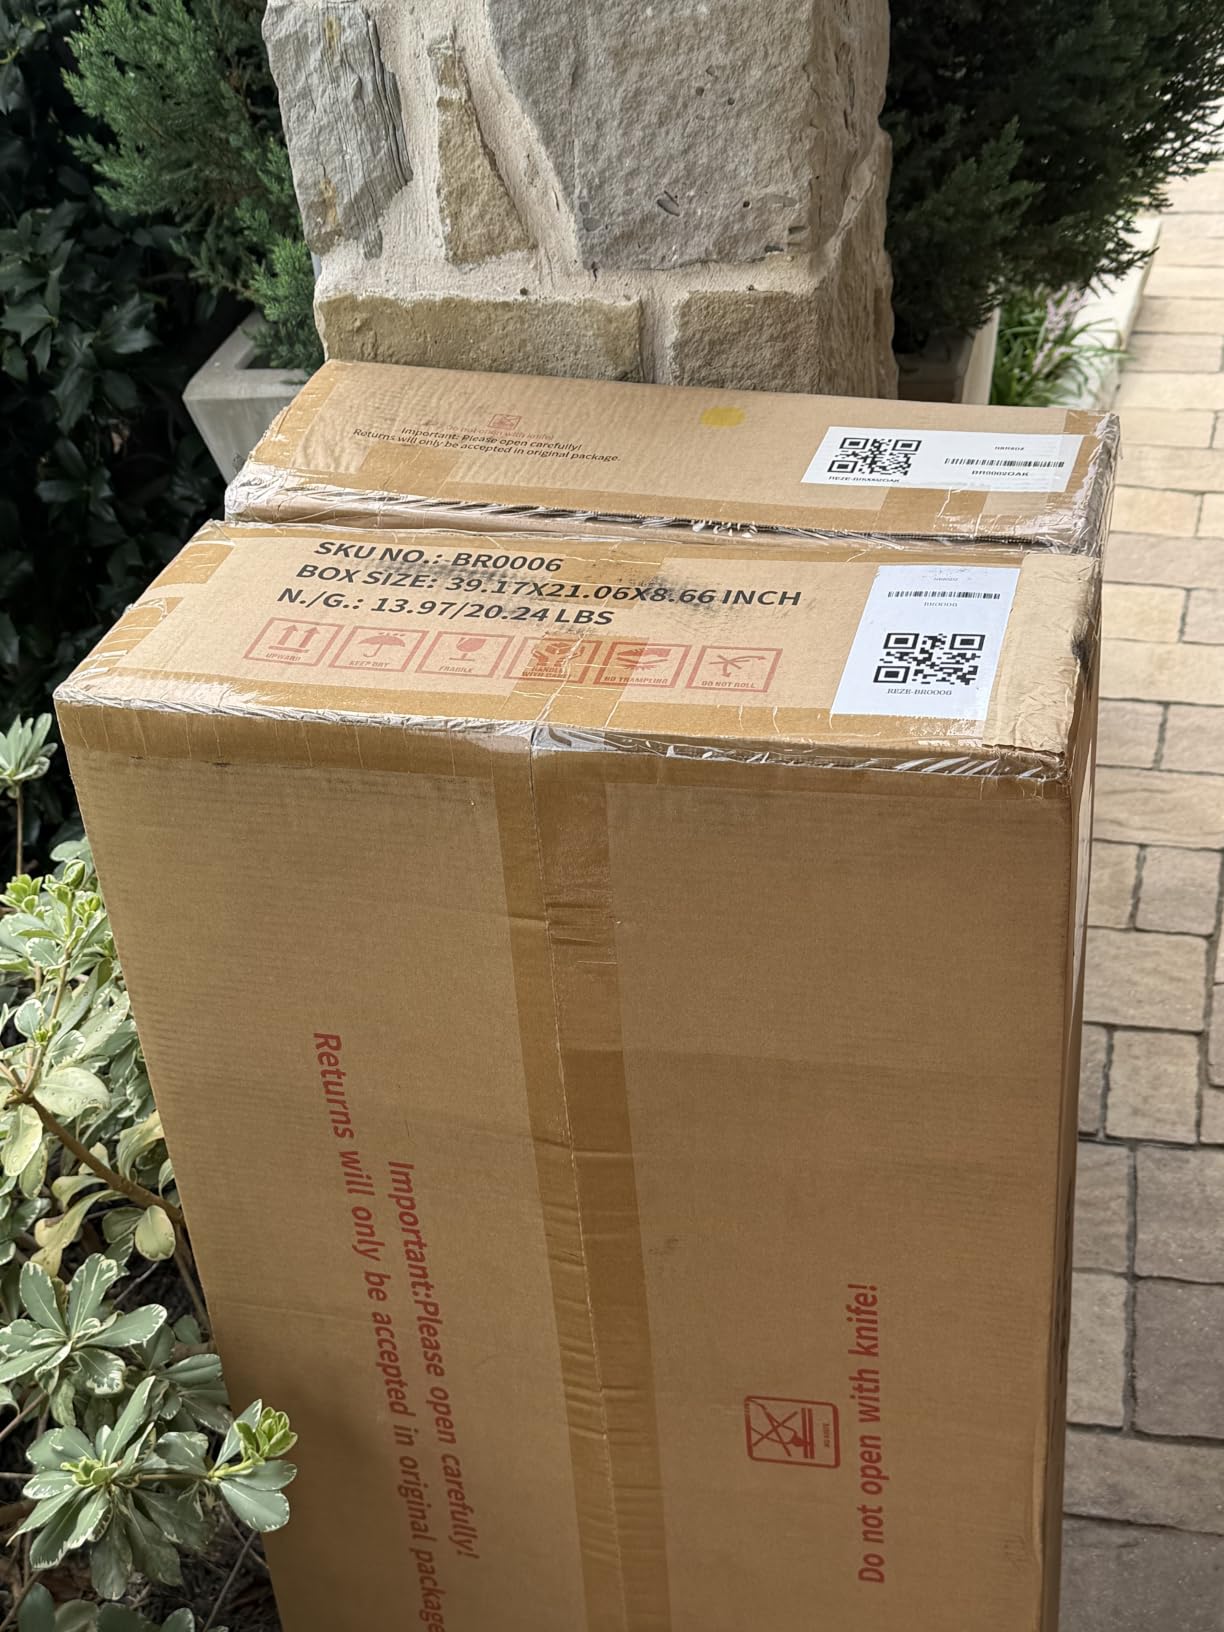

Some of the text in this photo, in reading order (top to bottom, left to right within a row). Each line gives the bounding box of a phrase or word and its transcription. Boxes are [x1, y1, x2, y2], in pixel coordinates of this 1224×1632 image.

[353, 428, 622, 463] Returns will only be accepted in original package.
[401, 427, 583, 451] Important: Please open carefully!
[314, 541, 563, 571] SKU NO.: BR0006
[277, 587, 615, 626] N./G.: 13.97/20.24 LBS
[296, 564, 802, 606] BOX SIZE: 39.17X21.06X8.66 INCH
[313, 1032, 355, 1139] Returns
[338, 1150, 376, 1196] will
[351, 1205, 386, 1262] only
[363, 1270, 392, 1302] be
[371, 1311, 417, 1417] accepted
[393, 1424, 419, 1448] in
[426, 1385, 457, 1445] open
[846, 1283, 890, 1584] Do not open with knife!
[397, 1455, 437, 1543] original
[441, 1453, 480, 1559] carefully!
